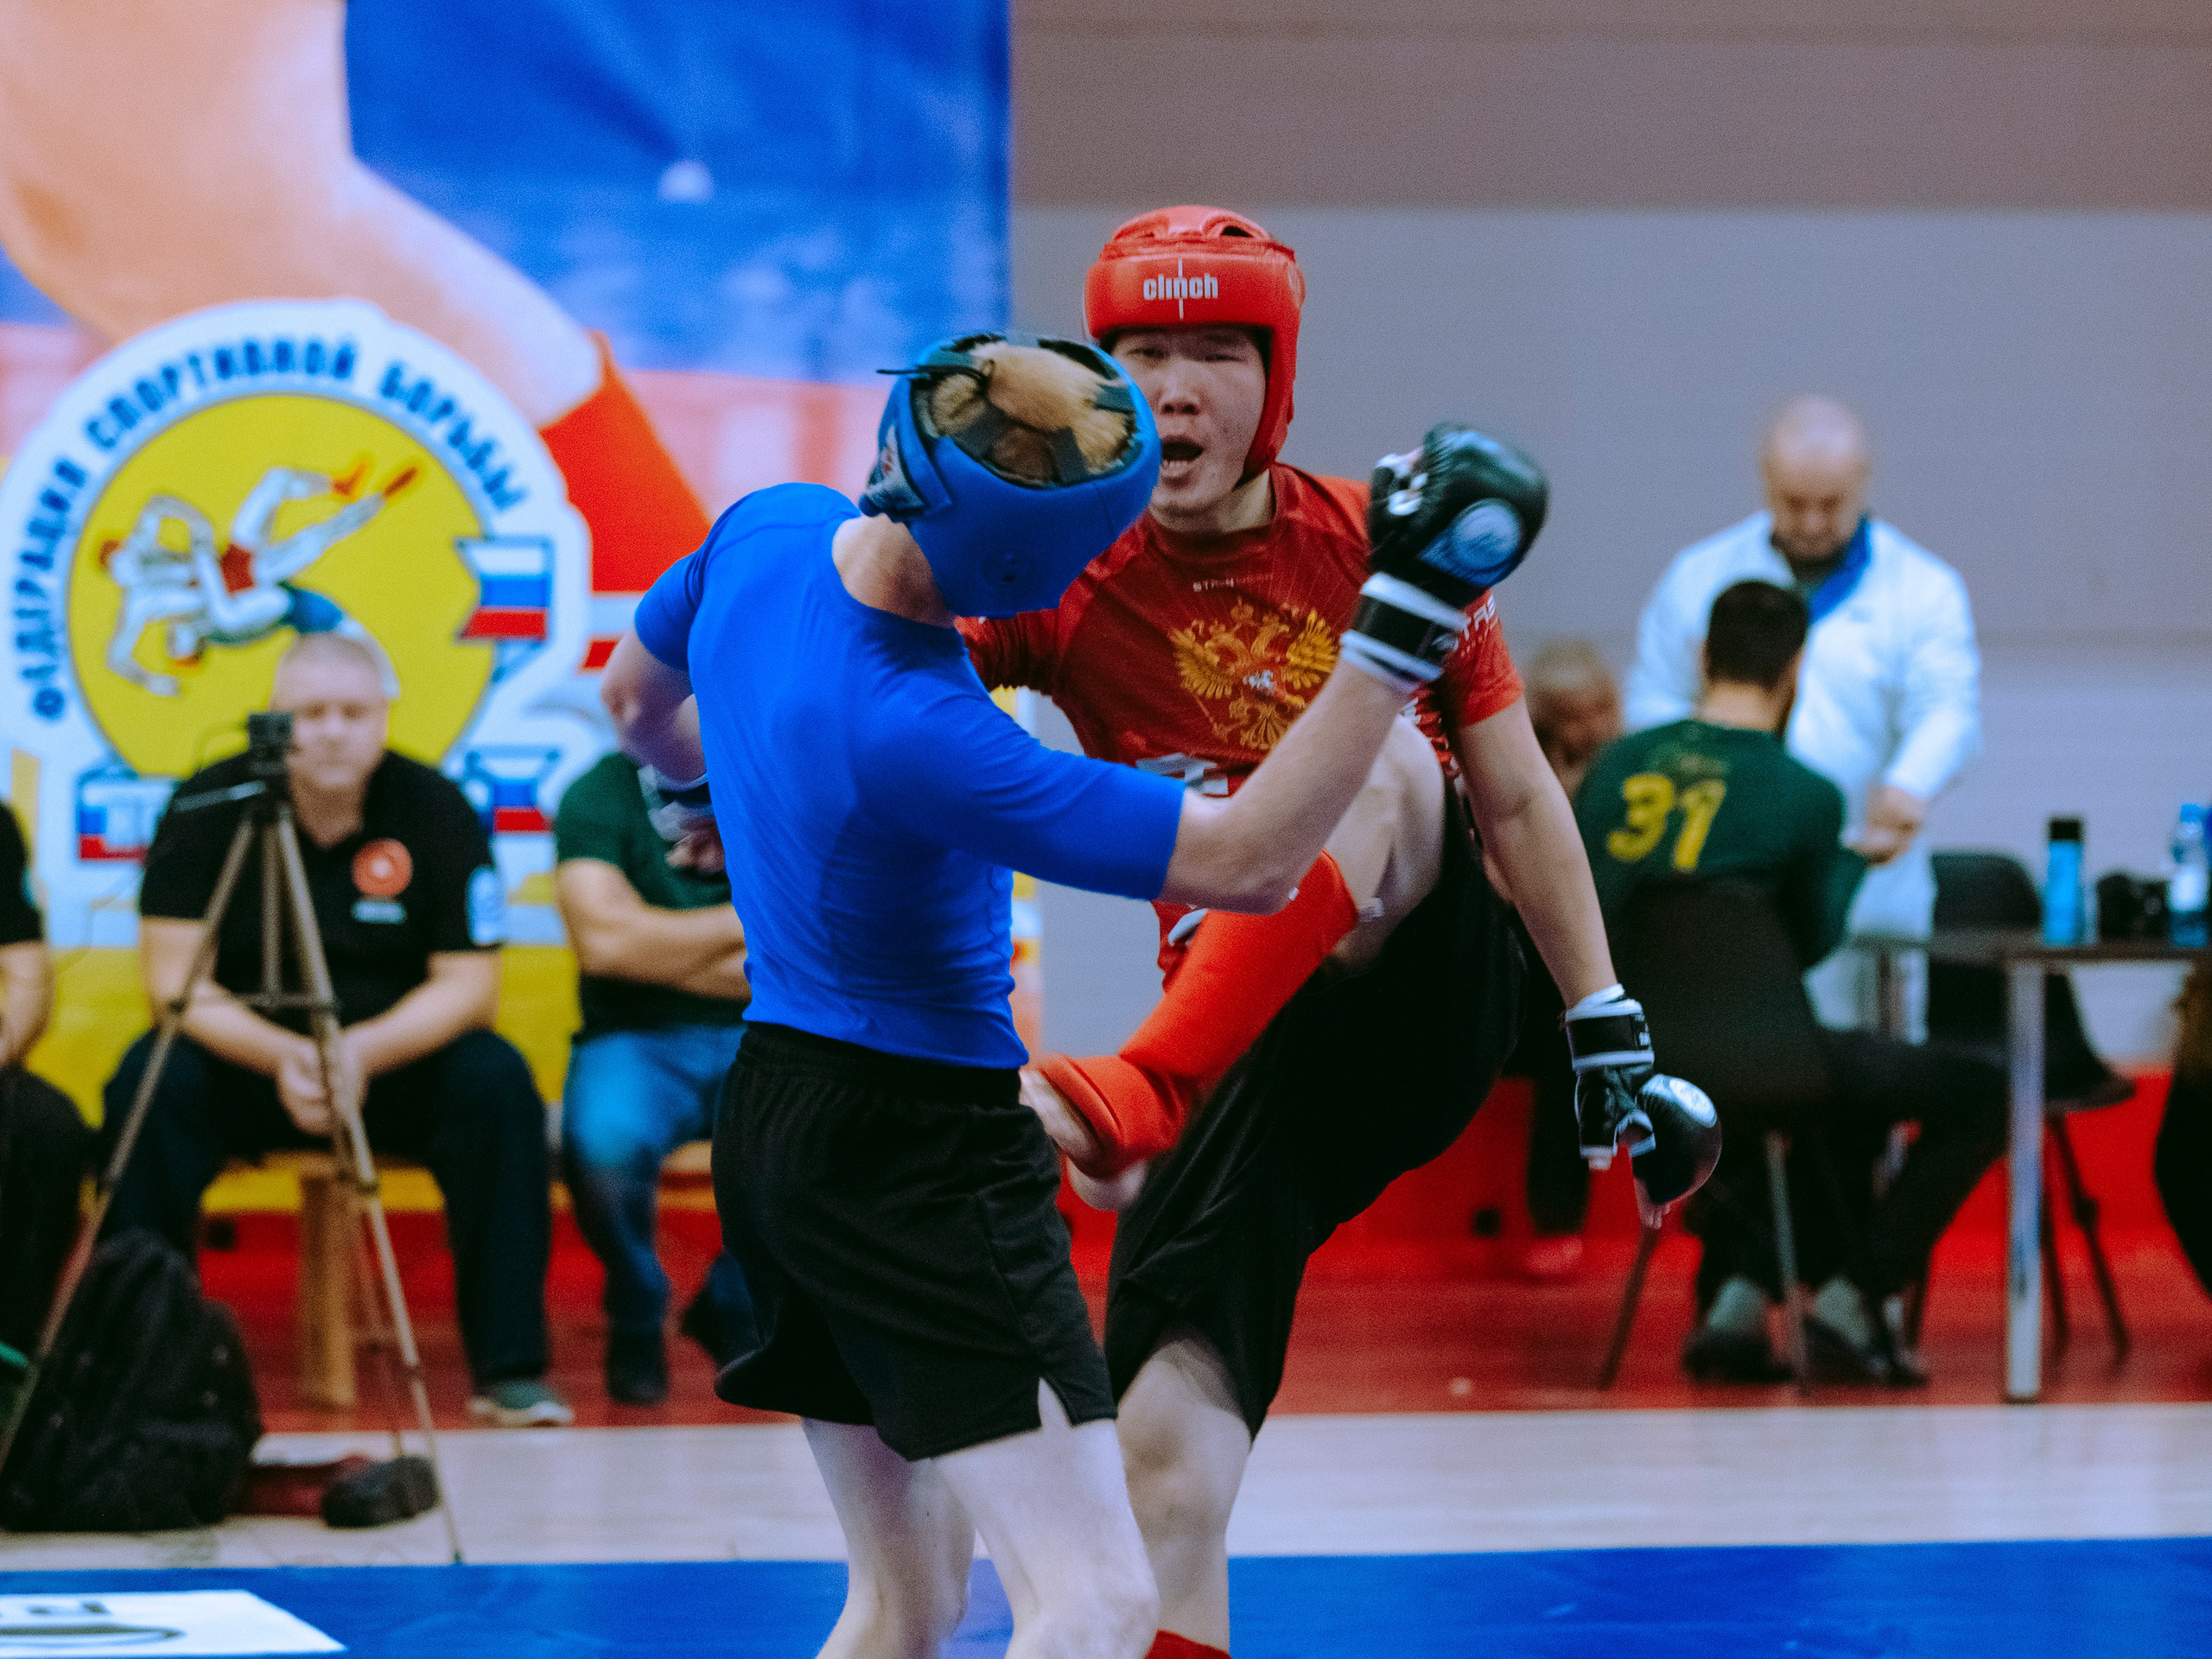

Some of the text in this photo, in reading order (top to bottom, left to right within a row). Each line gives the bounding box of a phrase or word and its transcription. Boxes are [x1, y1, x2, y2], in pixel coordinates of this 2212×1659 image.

[1143, 272, 1218, 301] clinch
[85, 336, 358, 449] СПОРТИВНОЙ
[380, 361, 527, 510] БОРЬБЫ
[1607, 774, 1726, 871] 31
